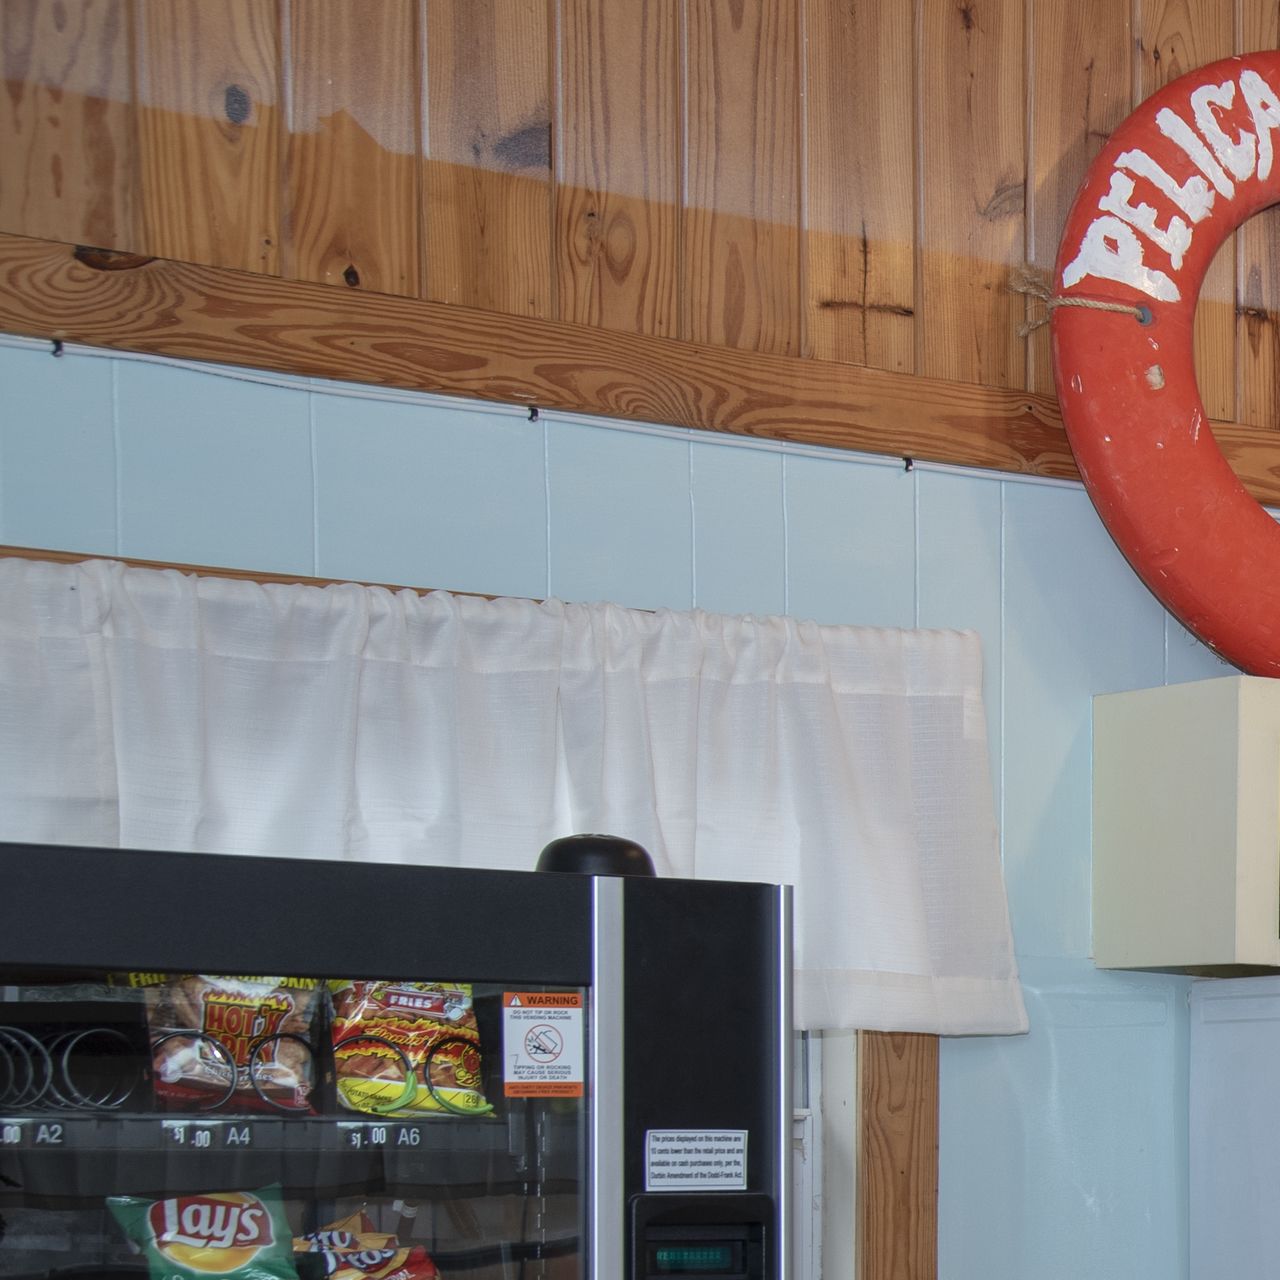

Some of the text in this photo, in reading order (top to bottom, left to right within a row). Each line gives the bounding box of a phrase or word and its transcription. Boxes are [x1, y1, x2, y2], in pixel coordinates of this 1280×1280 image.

[390, 995, 433, 1008] FRIES
[527, 996, 578, 1005] WARNING
[206, 1003, 256, 1034] HOT
[36, 1124, 63, 1144] A2
[227, 1126, 251, 1145] A4
[397, 1127, 420, 1146] A6
[159, 1198, 264, 1248] Lay's
